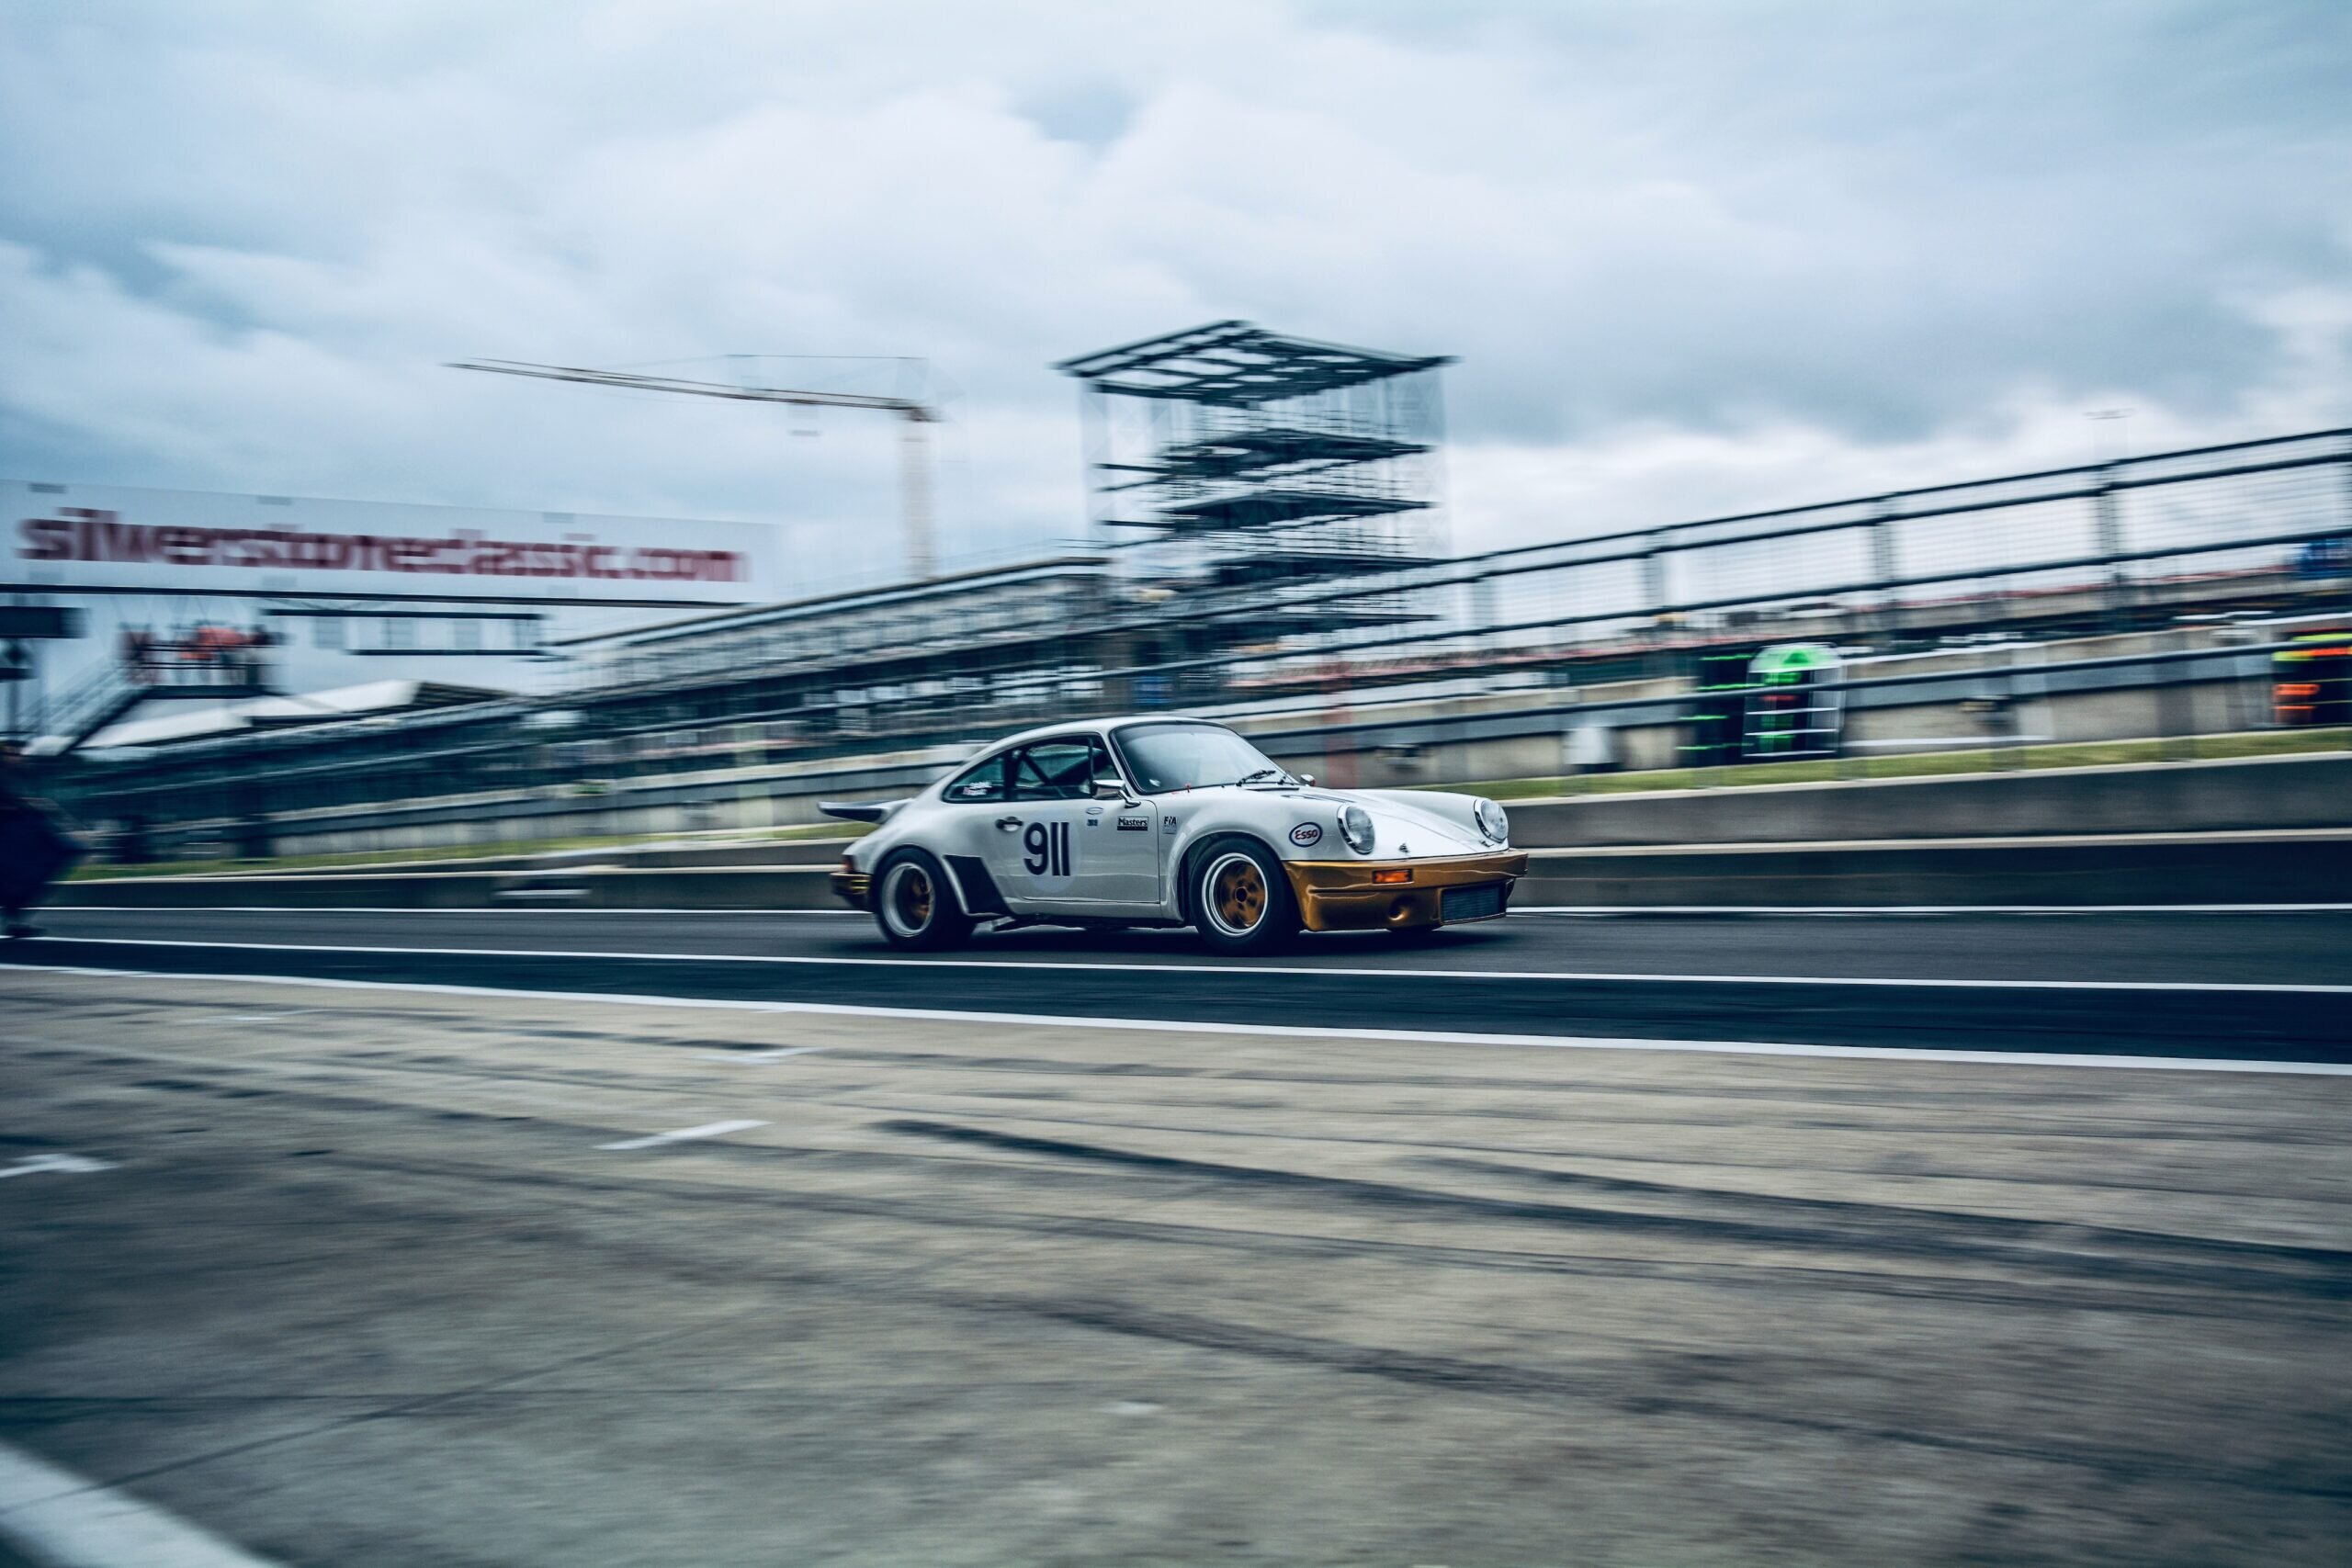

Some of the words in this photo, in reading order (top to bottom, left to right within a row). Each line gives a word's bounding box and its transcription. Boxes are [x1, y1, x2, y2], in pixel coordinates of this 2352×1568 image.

[15, 507, 752, 582] silverstoneclassic.com
[1118, 818, 1148, 827] Masters
[1164, 816, 1176, 825] FIA
[1295, 829, 1318, 840] Esso
[1023, 821, 1070, 876] 911
